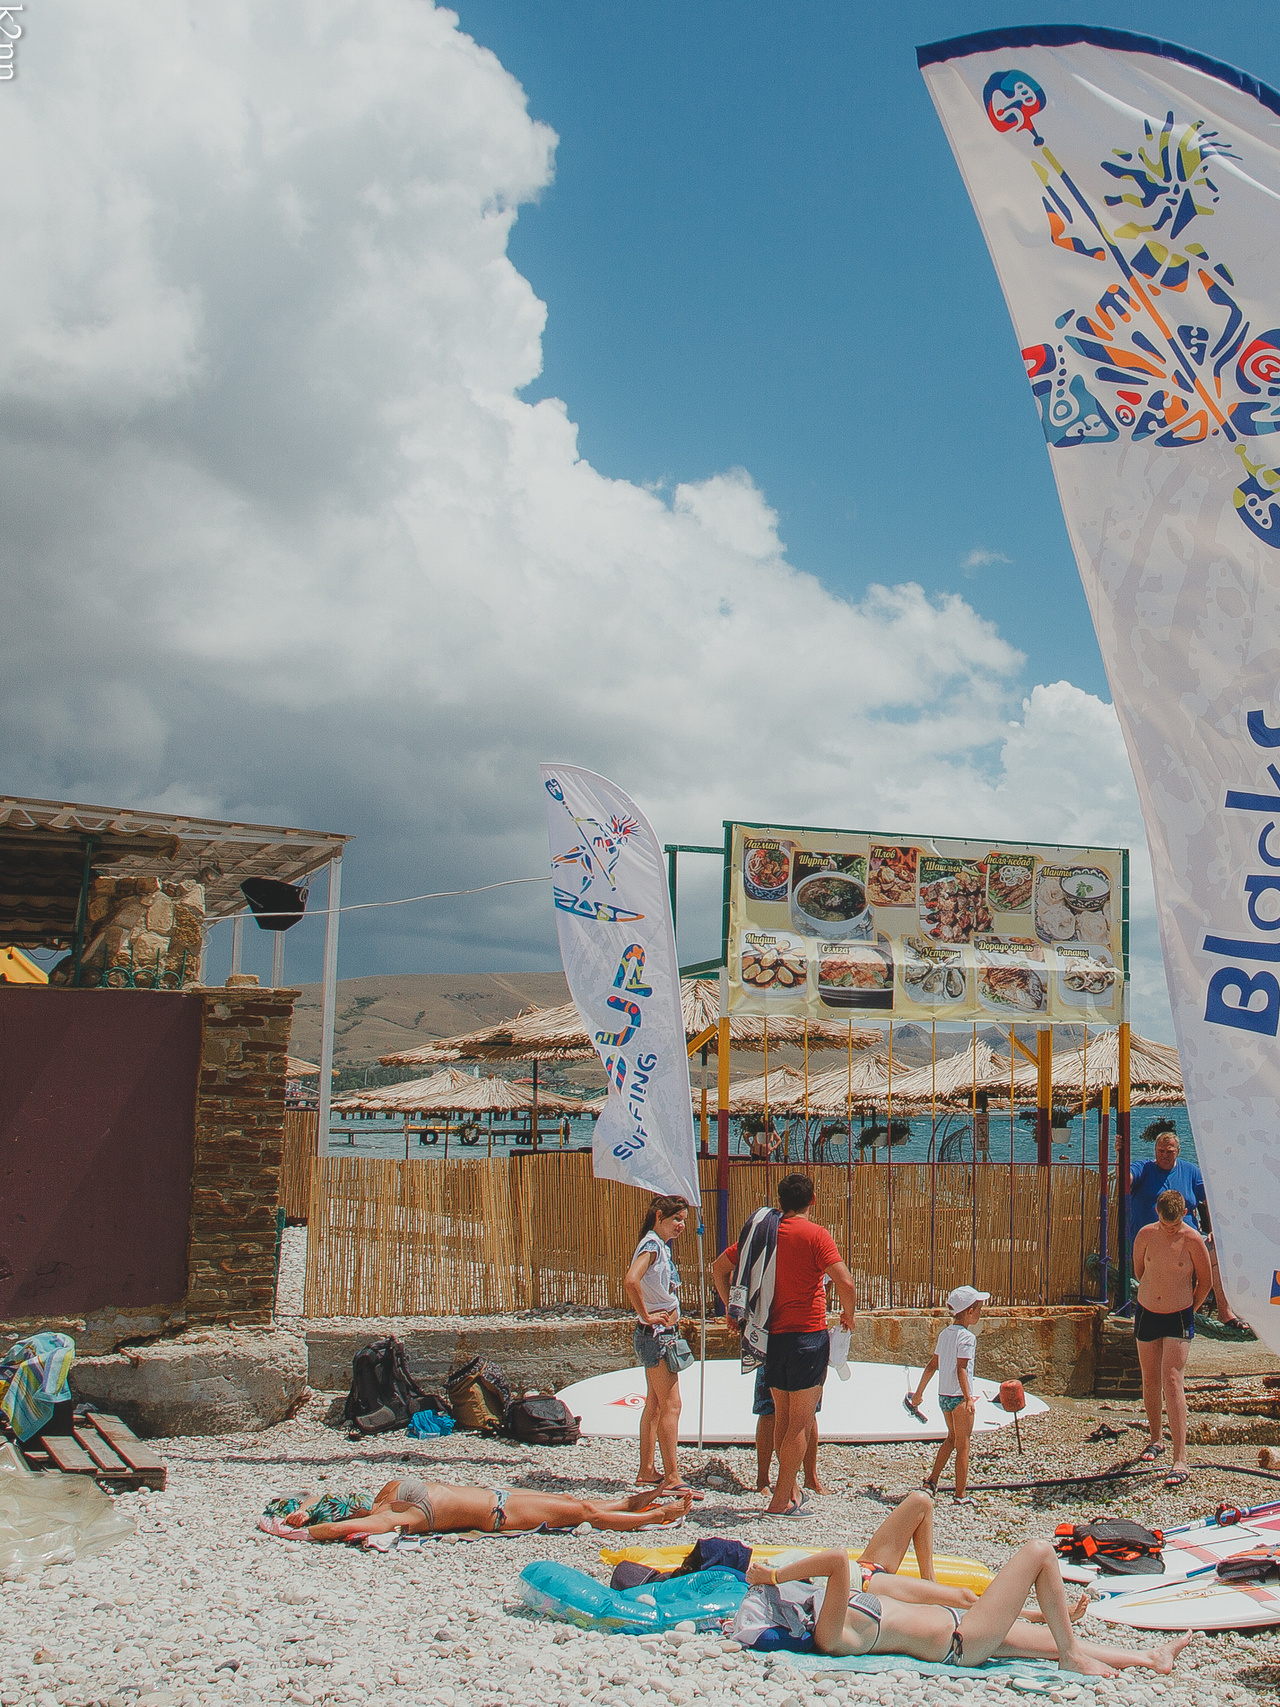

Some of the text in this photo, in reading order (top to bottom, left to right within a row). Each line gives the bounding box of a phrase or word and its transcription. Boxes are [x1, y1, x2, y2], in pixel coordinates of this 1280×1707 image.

[744, 837, 780, 851] Лагман
[874, 848, 896, 860] Плов
[984, 854, 1033, 867] Люля-кебаб
[798, 854, 830, 868] Шурпа
[924, 861, 963, 873] Шашлык
[1041, 867, 1074, 878] Манты
[745, 933, 777, 946] Мидии
[821, 943, 850, 955] Сёмга
[978, 940, 1035, 953] Дорадо гриль
